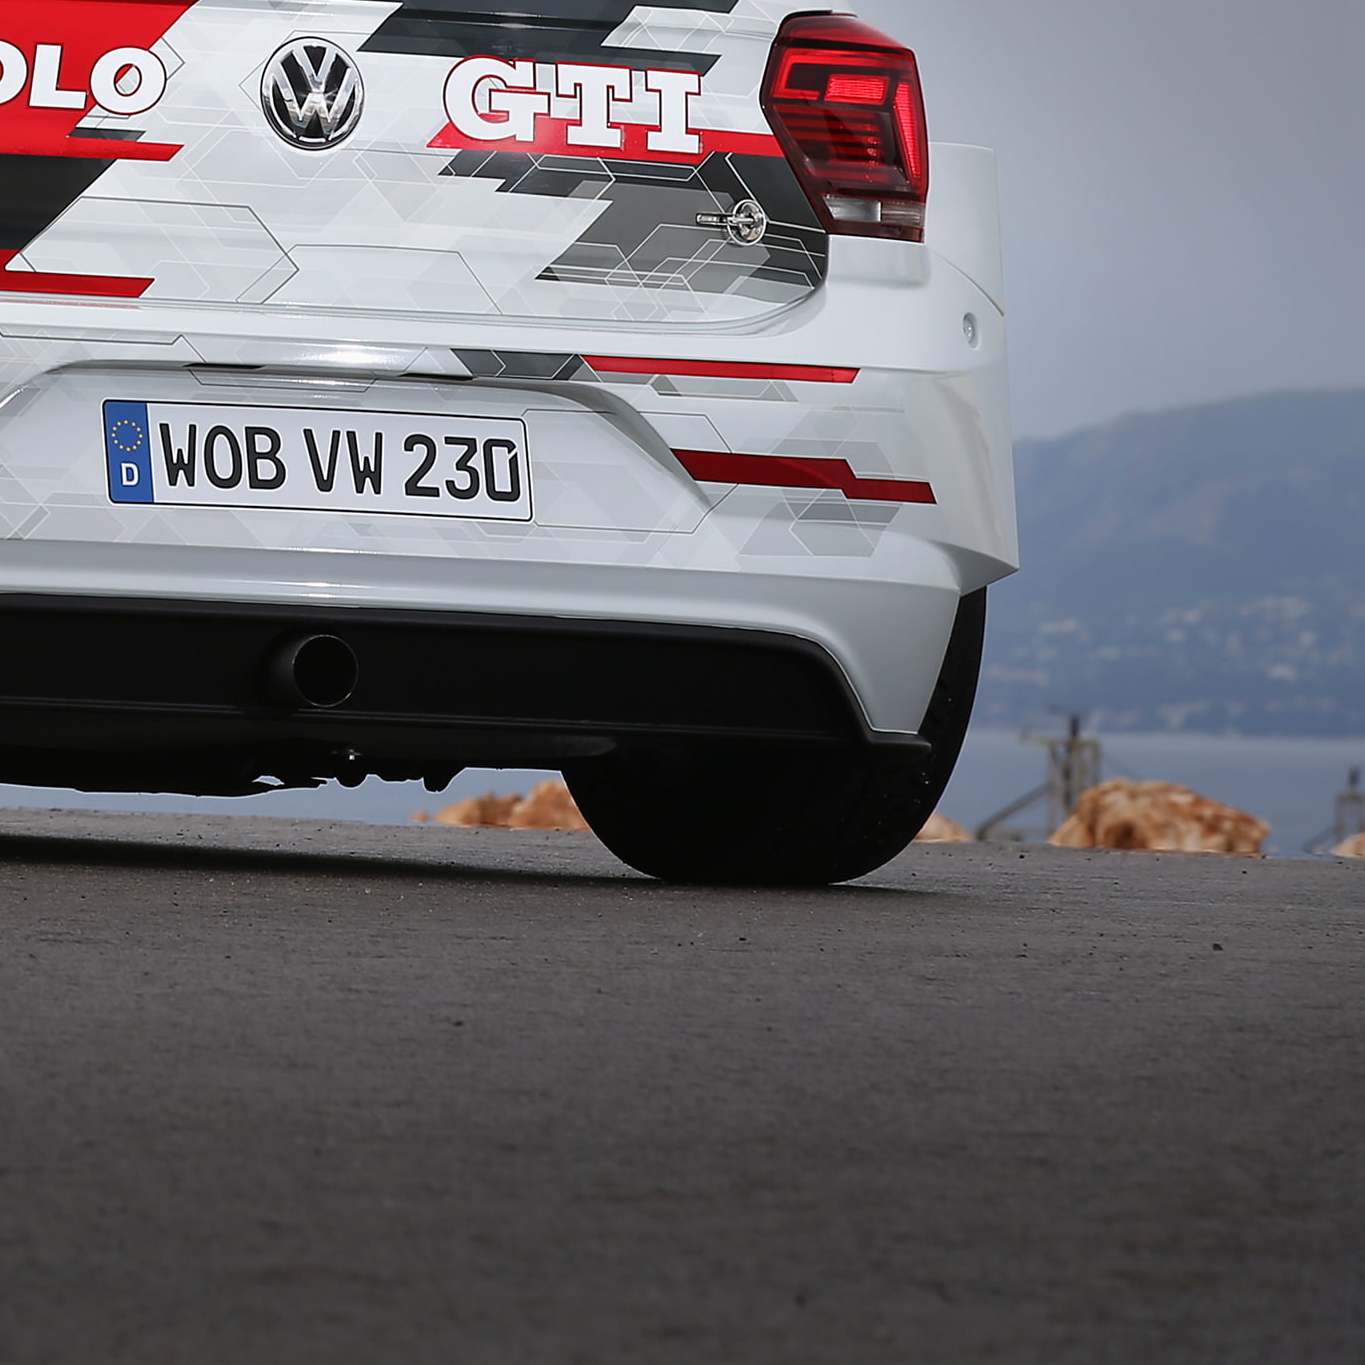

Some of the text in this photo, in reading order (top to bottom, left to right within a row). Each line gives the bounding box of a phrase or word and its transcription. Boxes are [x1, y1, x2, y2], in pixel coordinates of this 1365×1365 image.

[442, 56, 702, 153] GTI
[120, 464, 141, 487] D
[158, 422, 521, 503] WOB VW 230
